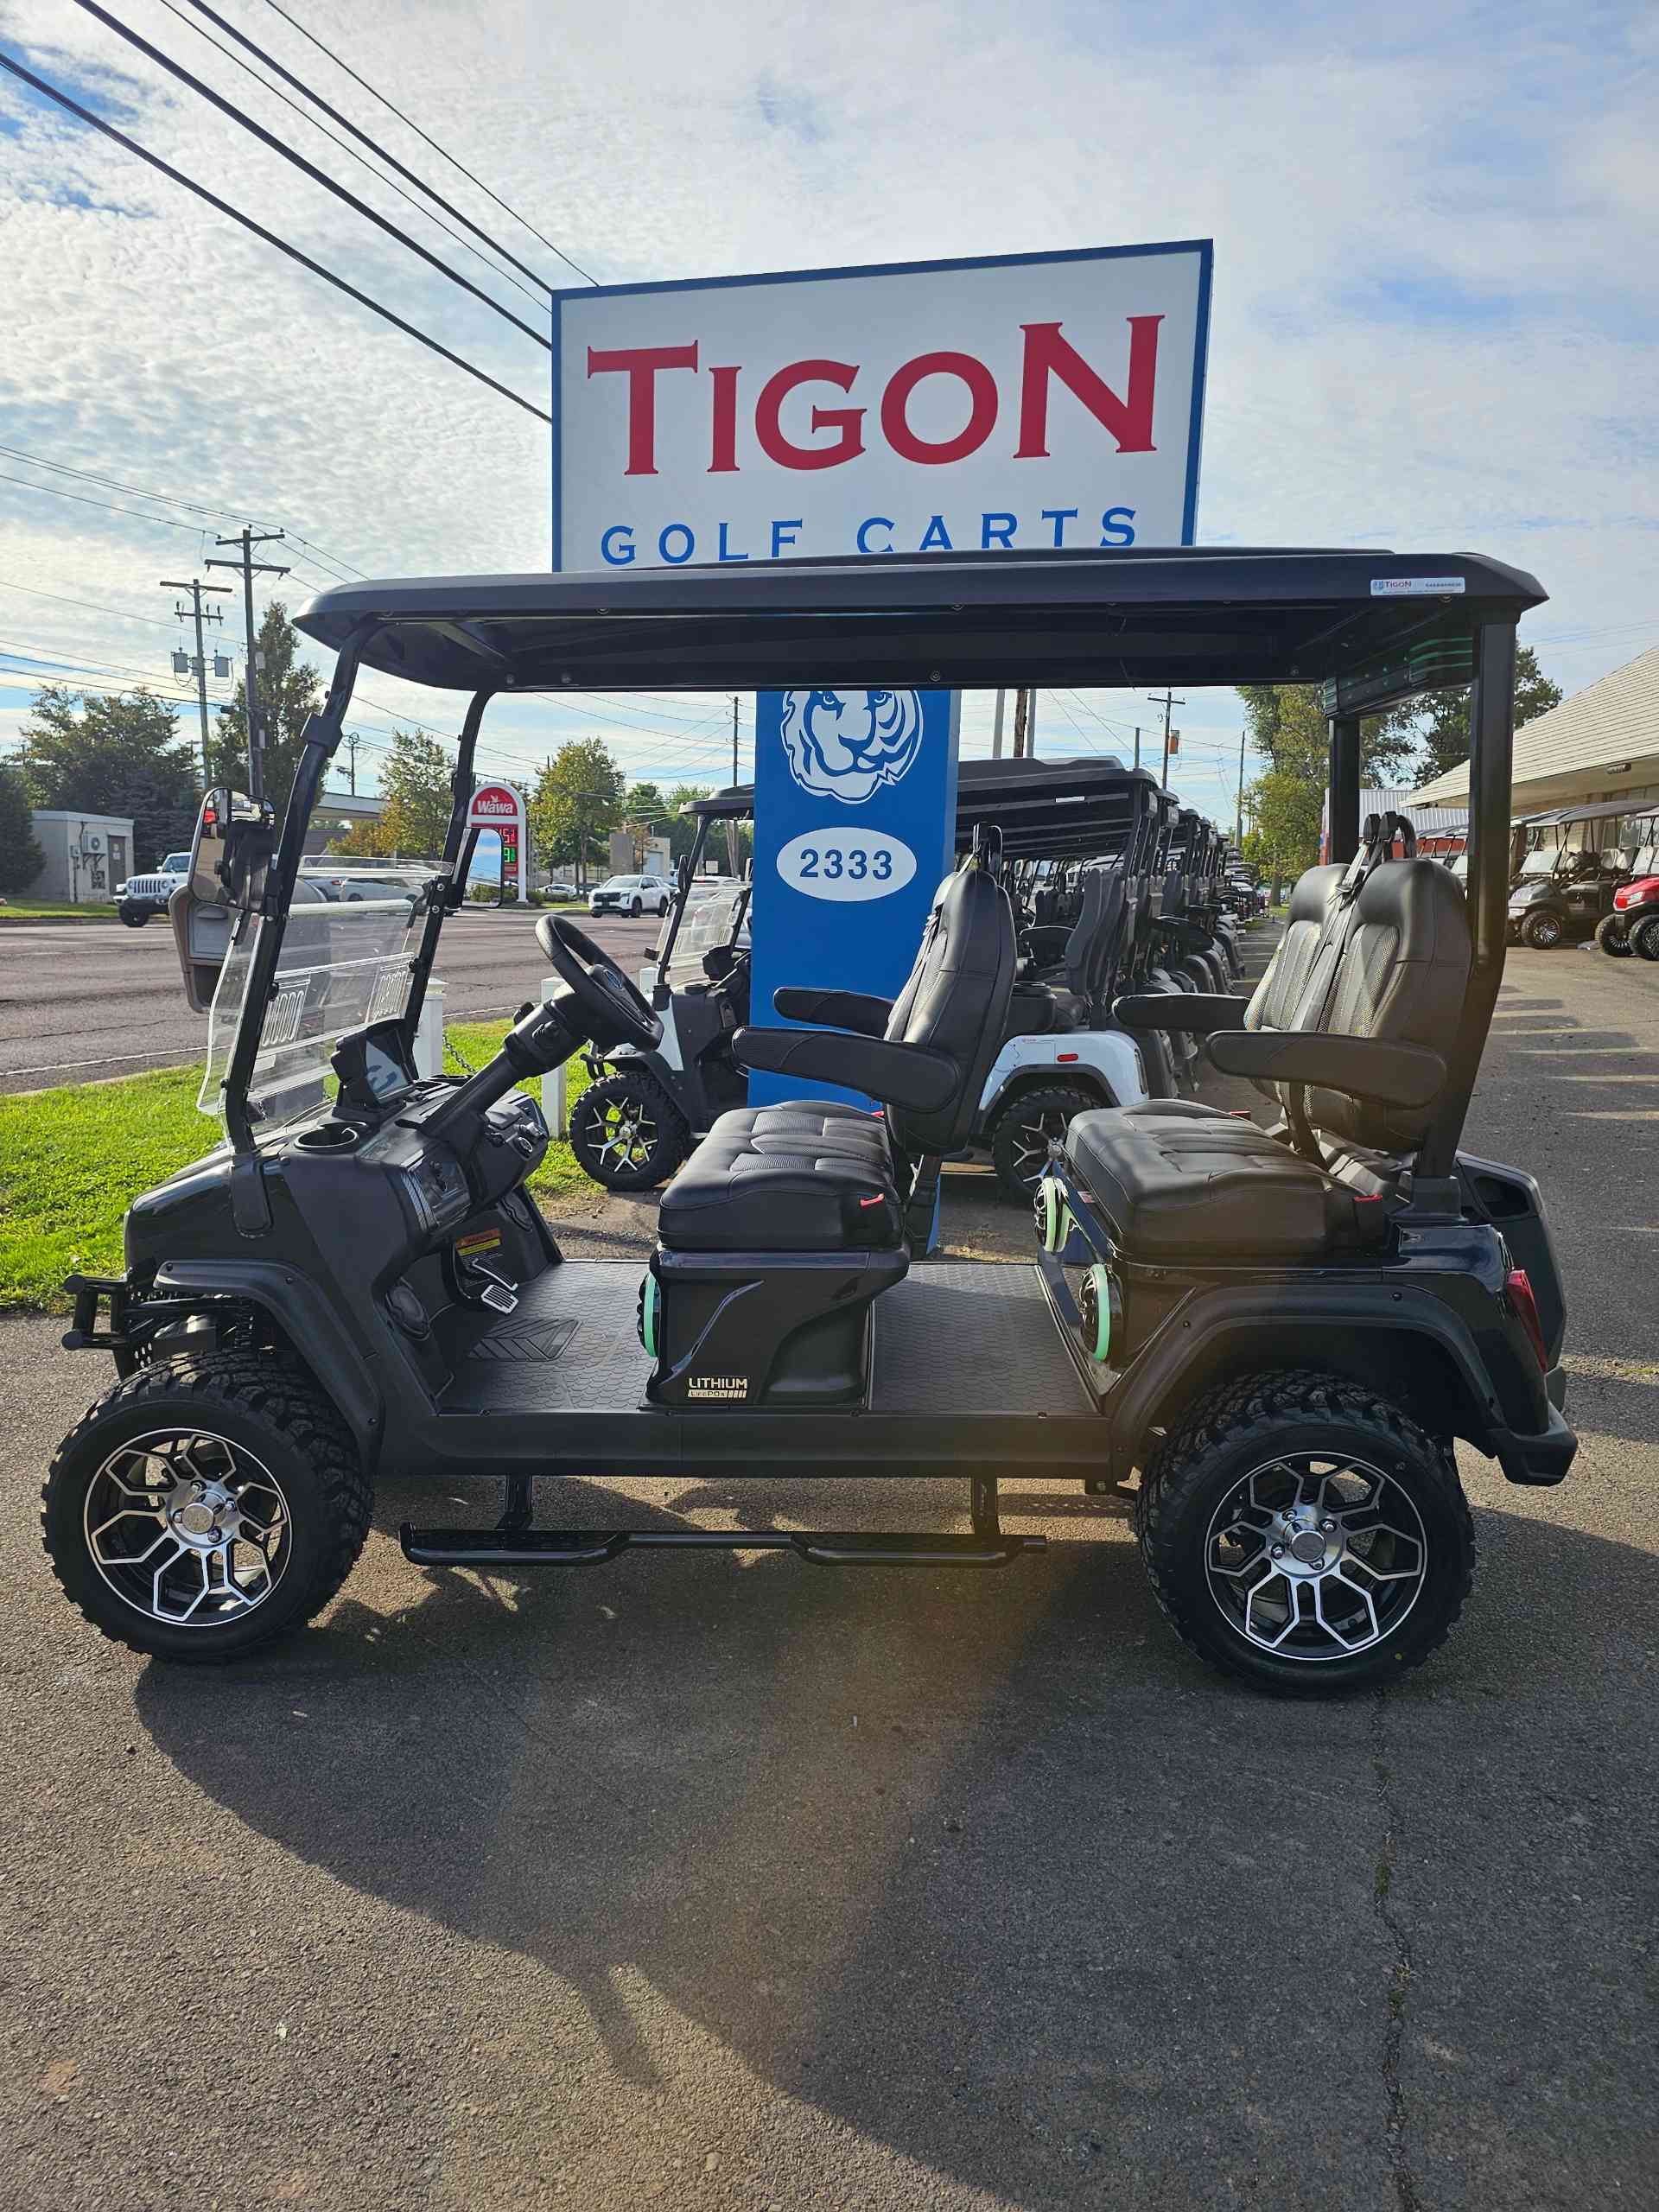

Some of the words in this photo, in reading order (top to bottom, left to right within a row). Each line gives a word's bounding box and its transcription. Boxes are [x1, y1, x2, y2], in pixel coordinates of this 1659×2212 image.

[588, 315, 1166, 474] TIGON
[601, 518, 802, 565] GOLF
[857, 507, 1135, 553] CARTS
[478, 800, 512, 814] Wawa
[800, 849, 892, 880] 2333
[689, 1378, 747, 1389] LITHIUM
